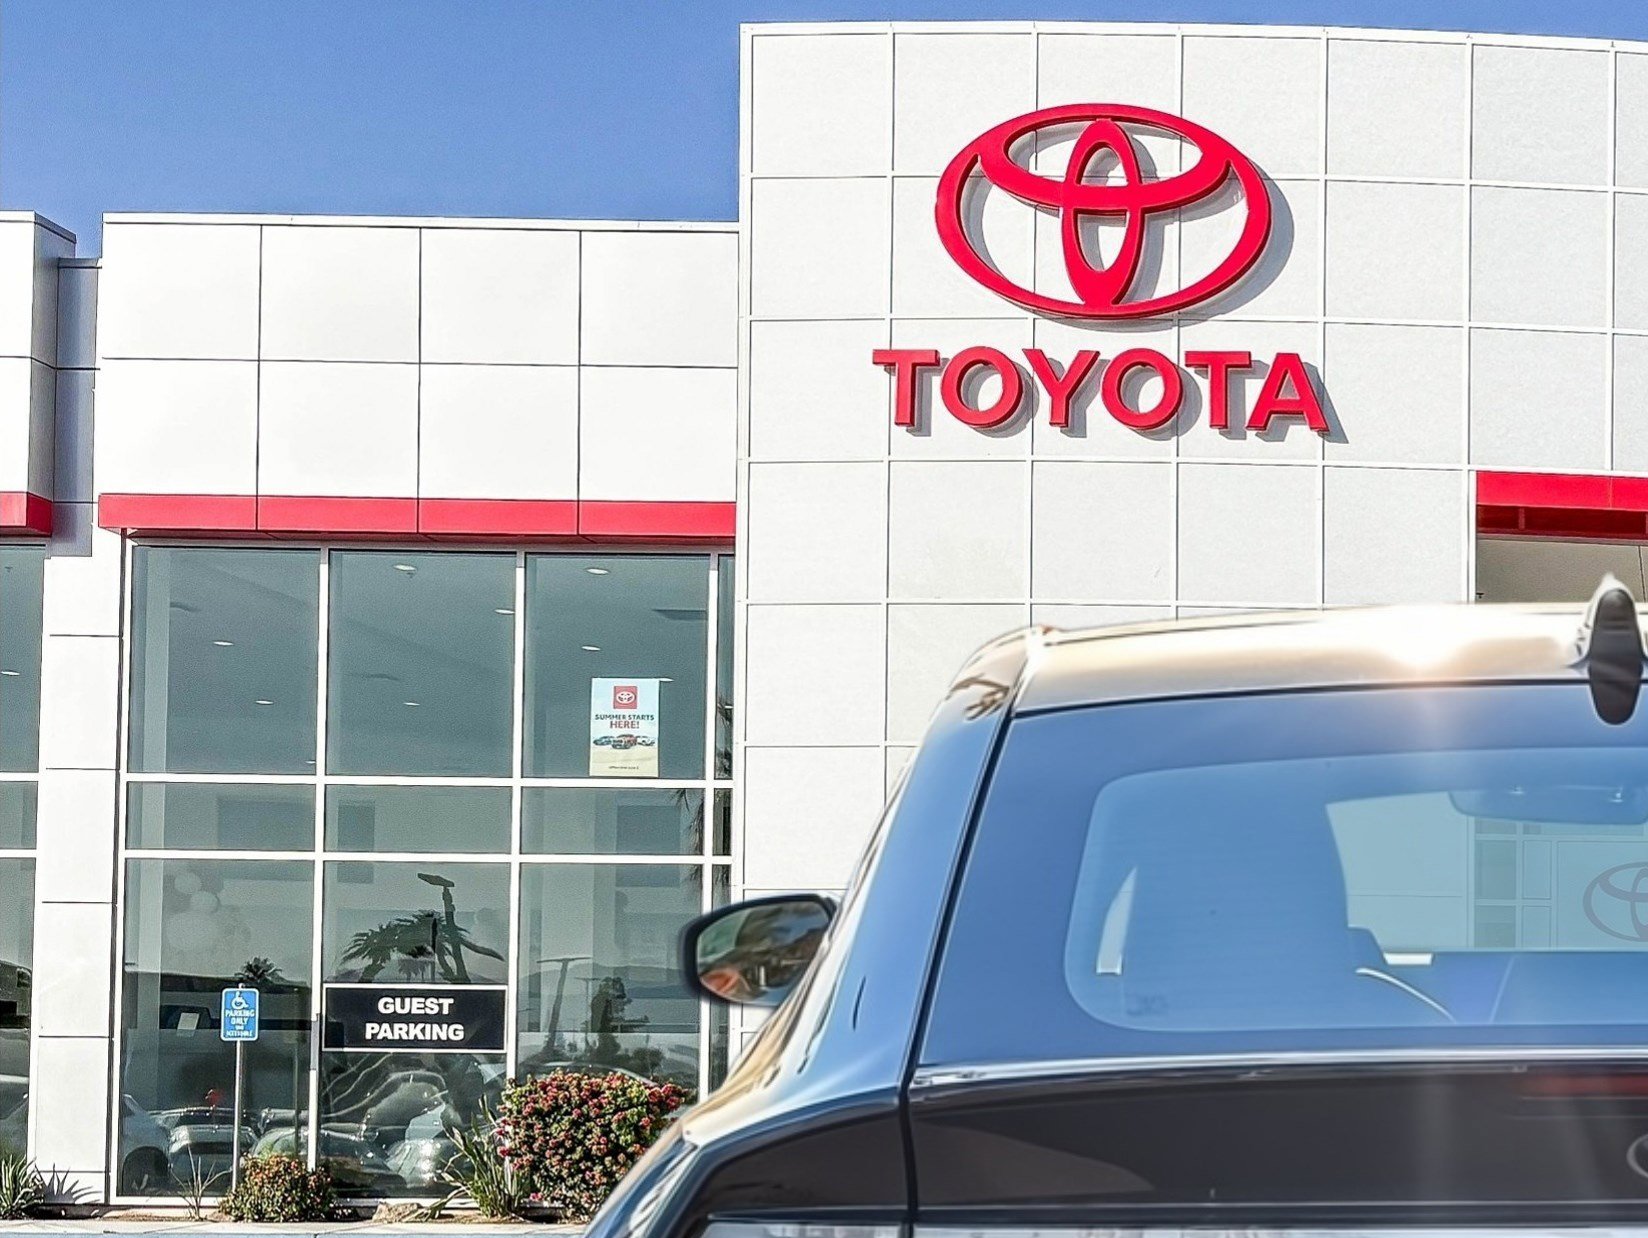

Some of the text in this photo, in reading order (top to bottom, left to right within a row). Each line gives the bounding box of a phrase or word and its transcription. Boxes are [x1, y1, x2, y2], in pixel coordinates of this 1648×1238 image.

[873, 346, 1330, 435] TOYOTA
[610, 720, 640, 729] HERE!
[225, 1009, 255, 1017] PARKING
[377, 997, 454, 1015] GUEST
[365, 1023, 465, 1041] PARKING
